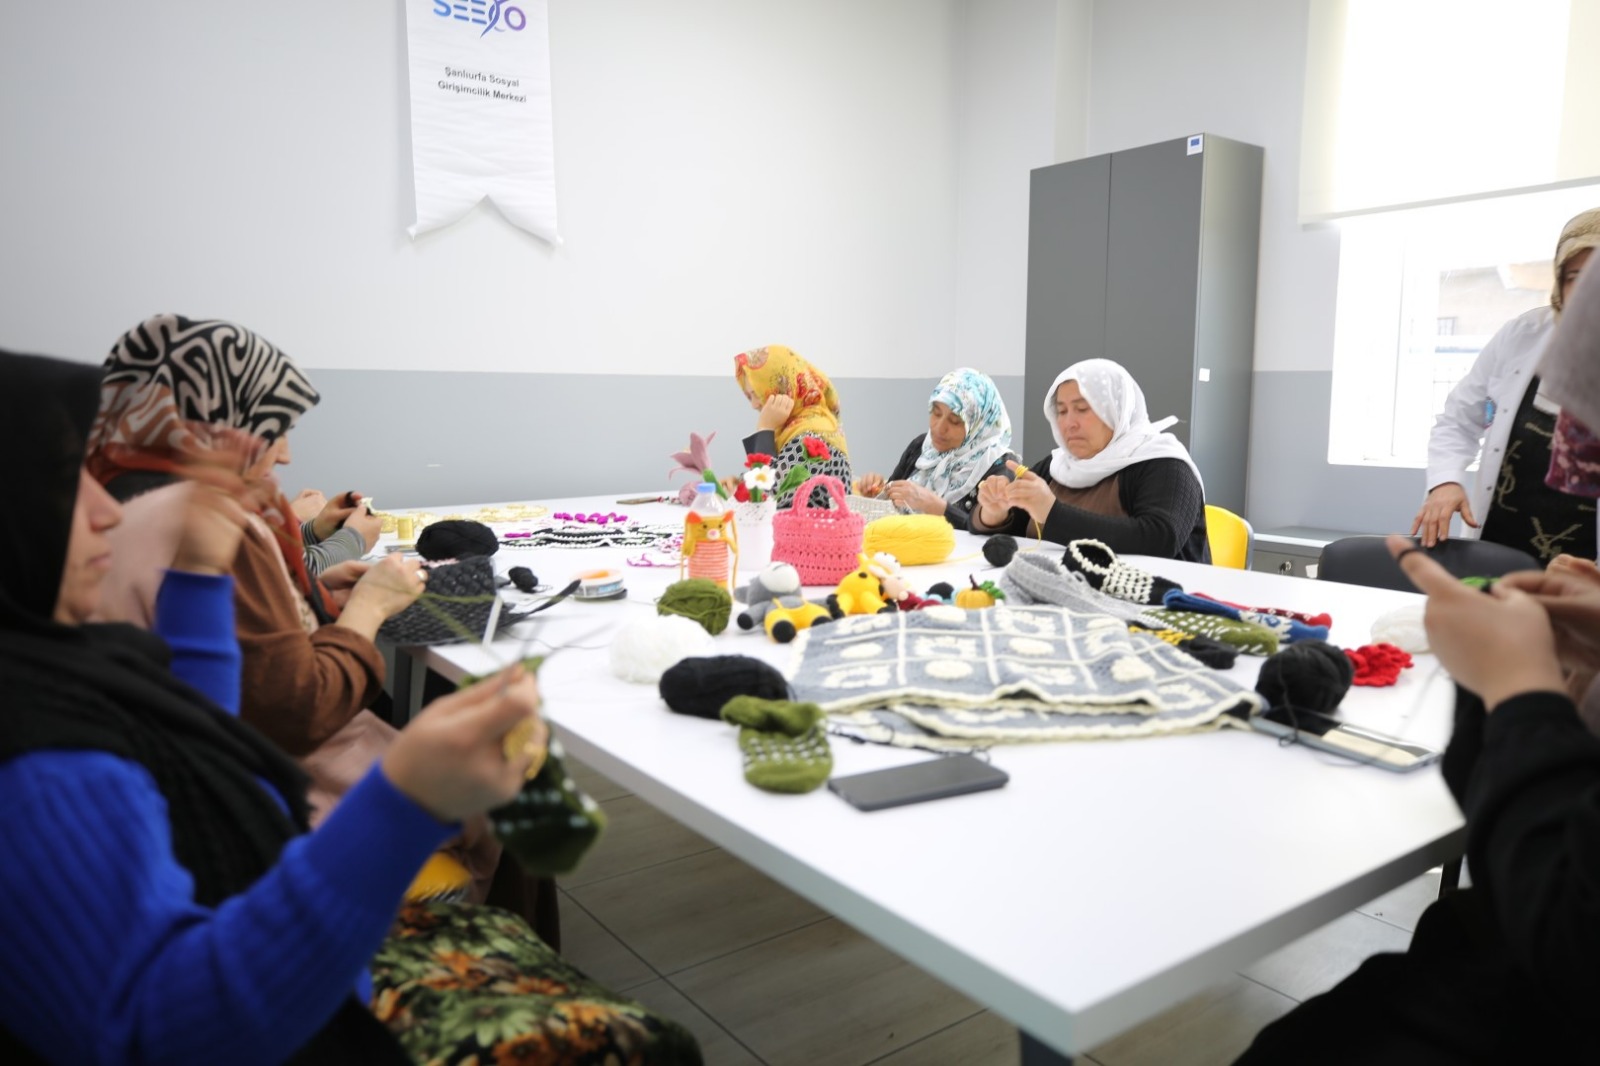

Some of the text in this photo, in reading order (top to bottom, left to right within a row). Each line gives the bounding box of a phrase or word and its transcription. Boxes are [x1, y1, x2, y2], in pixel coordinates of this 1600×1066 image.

[444, 66, 520, 87] Şanlıurfa Sosyal
[437, 80, 527, 103] Girişimcilik Merkezi
